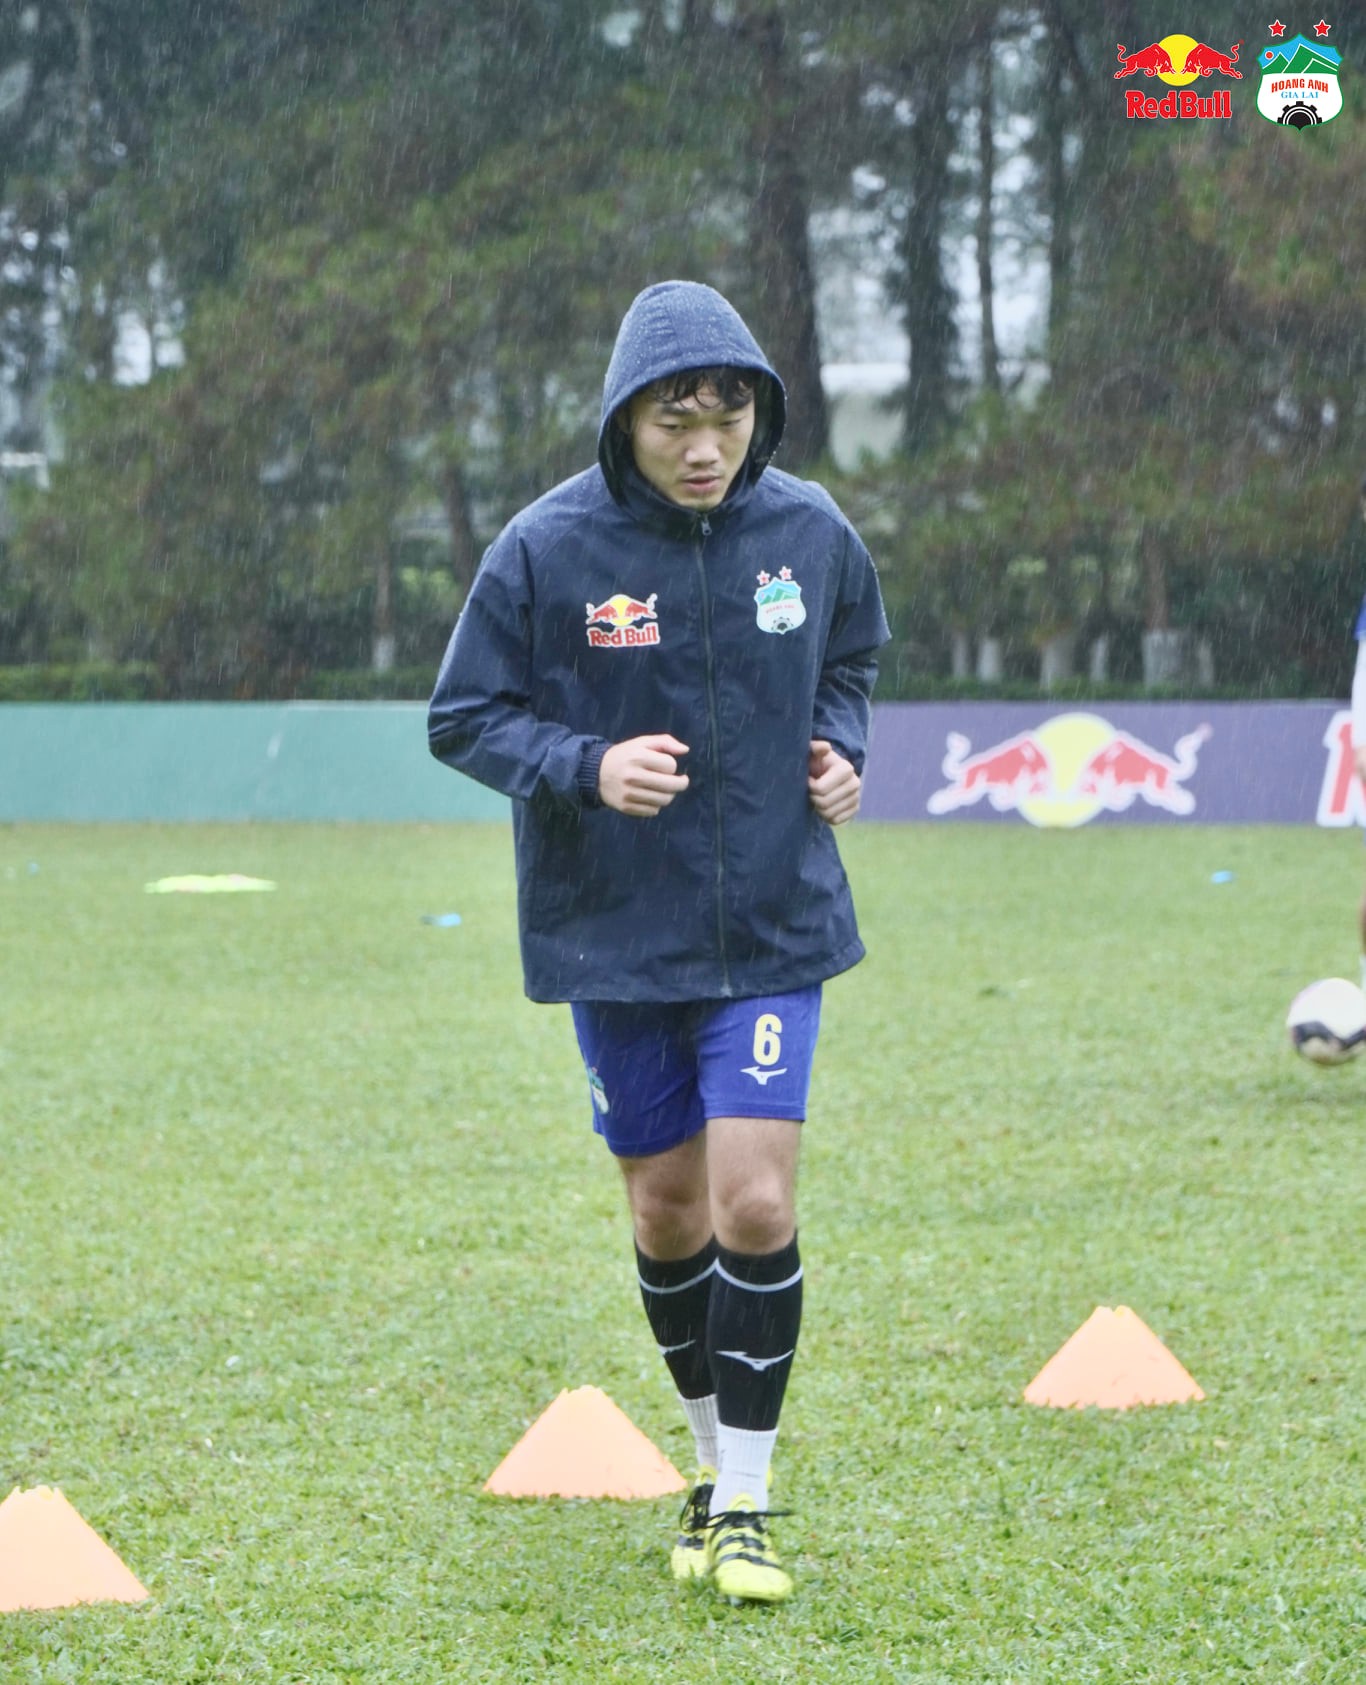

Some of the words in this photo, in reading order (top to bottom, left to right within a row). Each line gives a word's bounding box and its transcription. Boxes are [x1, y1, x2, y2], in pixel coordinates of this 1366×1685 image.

[588, 629, 623, 646] Red
[624, 625, 657, 645] Bull
[752, 1013, 783, 1066] 6
